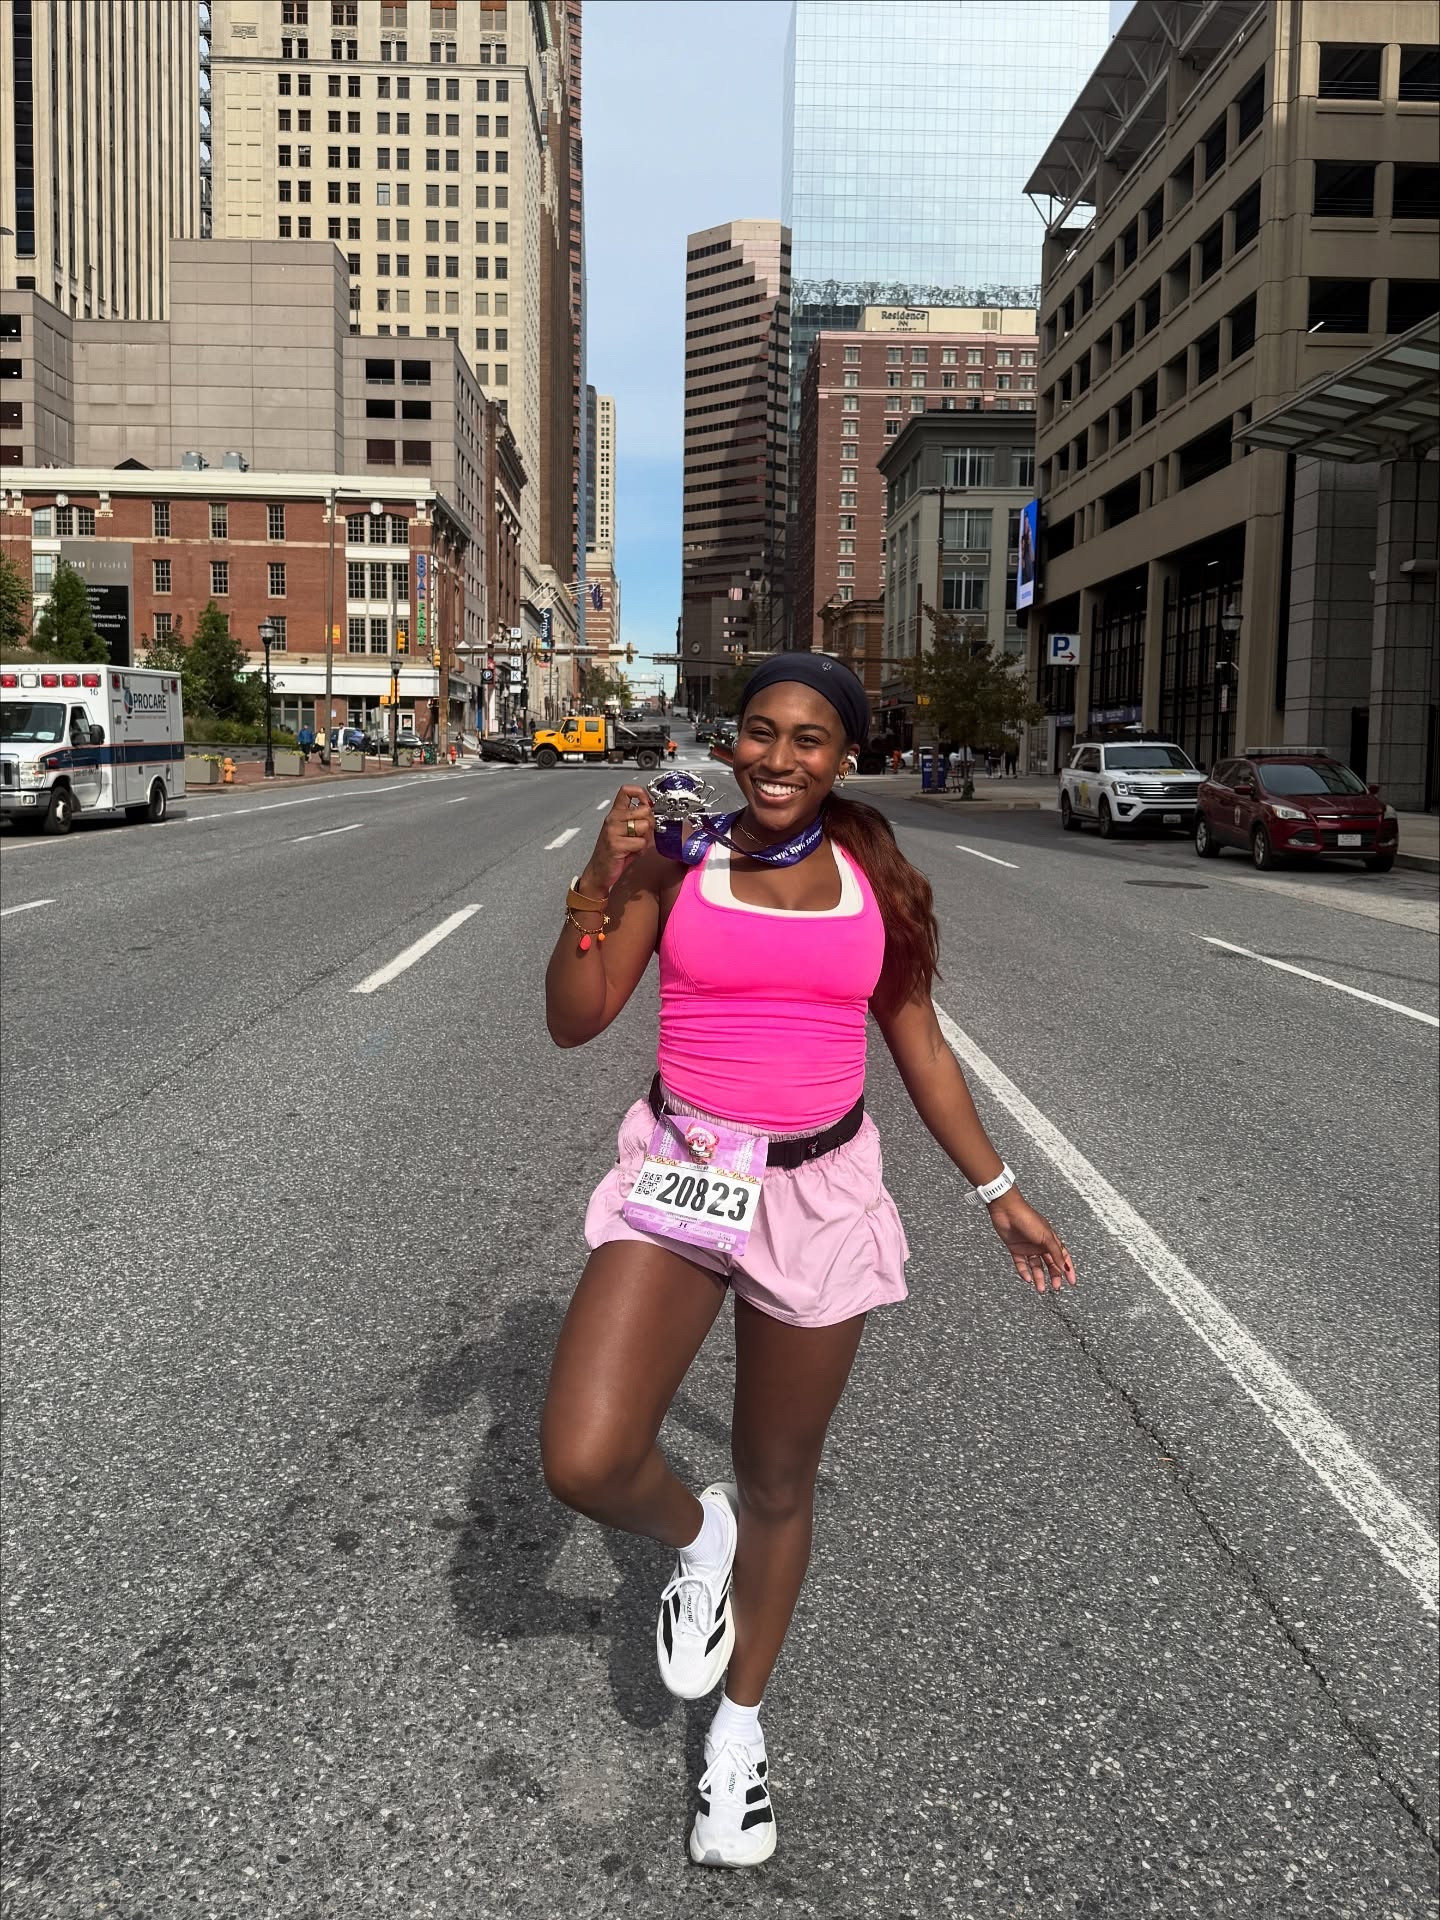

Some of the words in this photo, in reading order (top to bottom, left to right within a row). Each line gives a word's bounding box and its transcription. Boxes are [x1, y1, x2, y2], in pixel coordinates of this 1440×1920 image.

[881, 310, 926, 320] Residence
[416, 554, 426, 599] ROYAL
[418, 601, 426, 646] FARMS
[1053, 636, 1070, 657] P
[89, 688, 99, 696] 16
[133, 692, 167, 710] PROCARE
[689, 840, 701, 856] 2025
[656, 1172, 750, 1222] 20823
